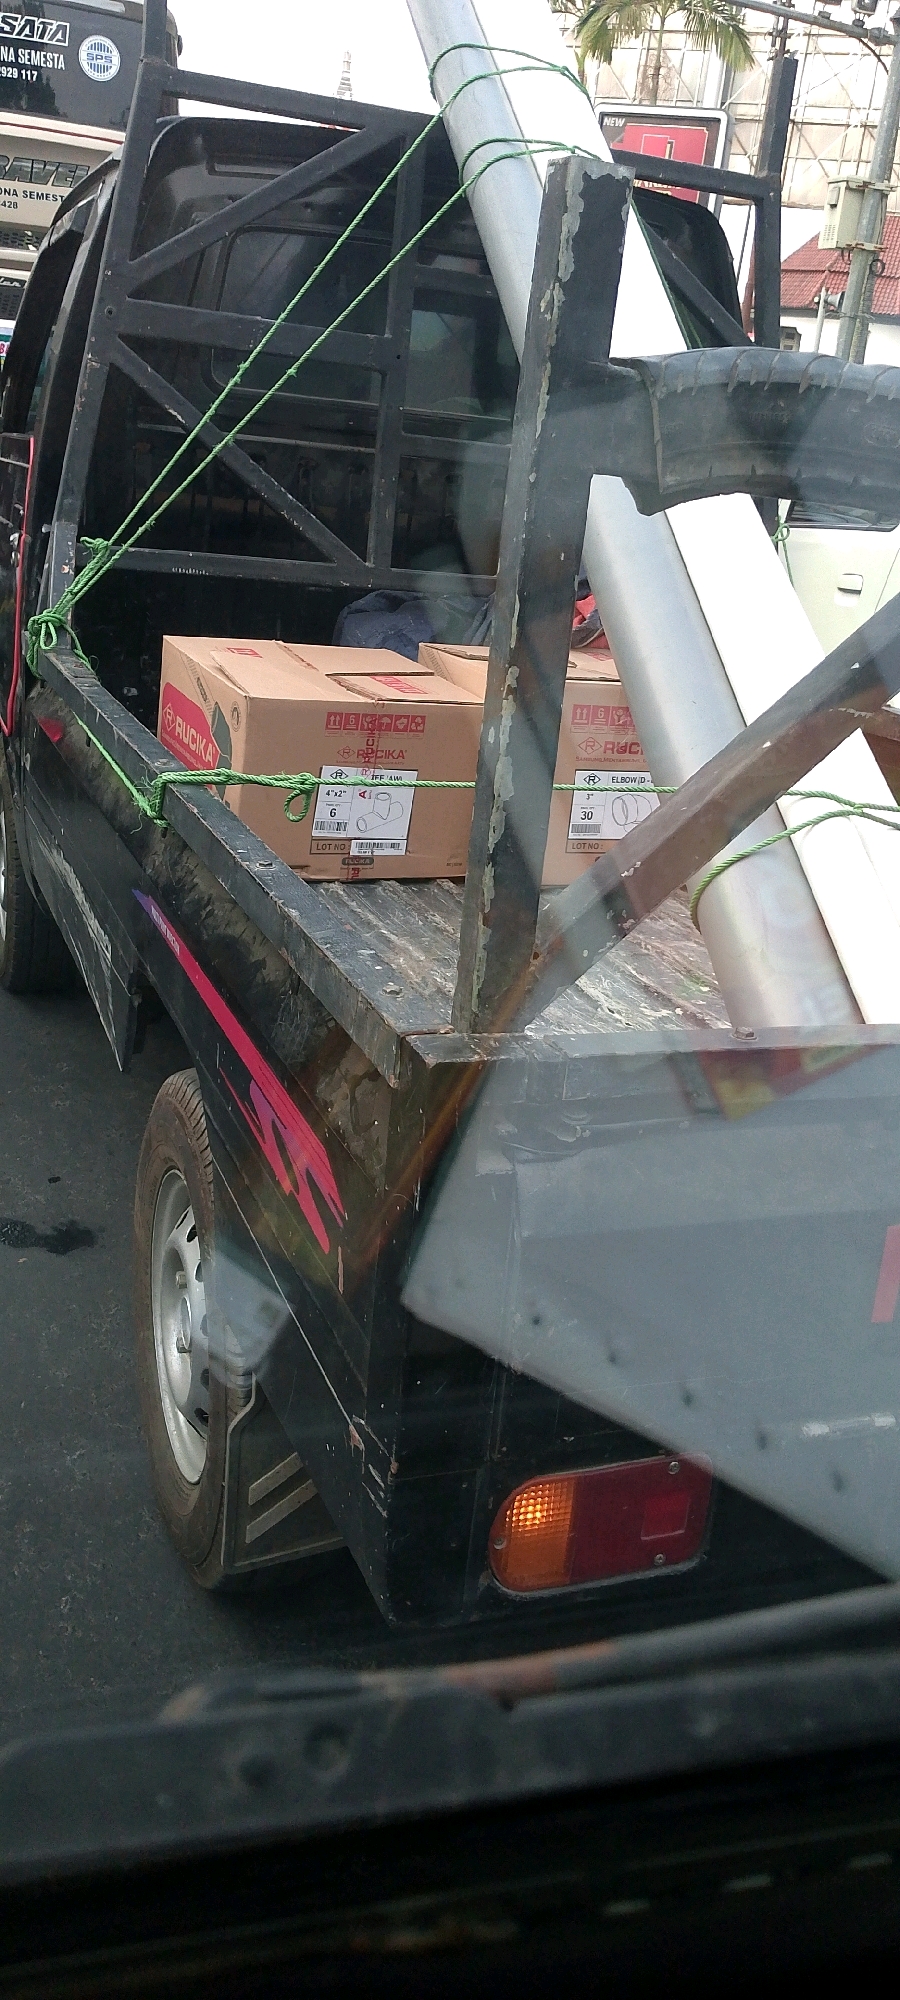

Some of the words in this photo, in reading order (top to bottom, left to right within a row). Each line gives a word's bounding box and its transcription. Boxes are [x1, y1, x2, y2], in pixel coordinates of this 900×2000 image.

[0, 13, 69, 46] SATA
[0, 45, 15, 63] NA
[18, 48, 65, 71] SEMESTA
[87, 53, 112, 64] SPS
[21, 69, 38, 82] 117
[603, 117, 625, 127] NEW
[175, 715, 213, 768] RUCIKA
[611, 776, 637, 784] ELBOW
[325, 789, 347, 798] 4"x2"
[329, 808, 337, 818] 6
[580, 810, 594, 821] 30
[316, 843, 333, 851] LOT
[334, 843, 346, 851] NO
[572, 842, 587, 850] LOT
